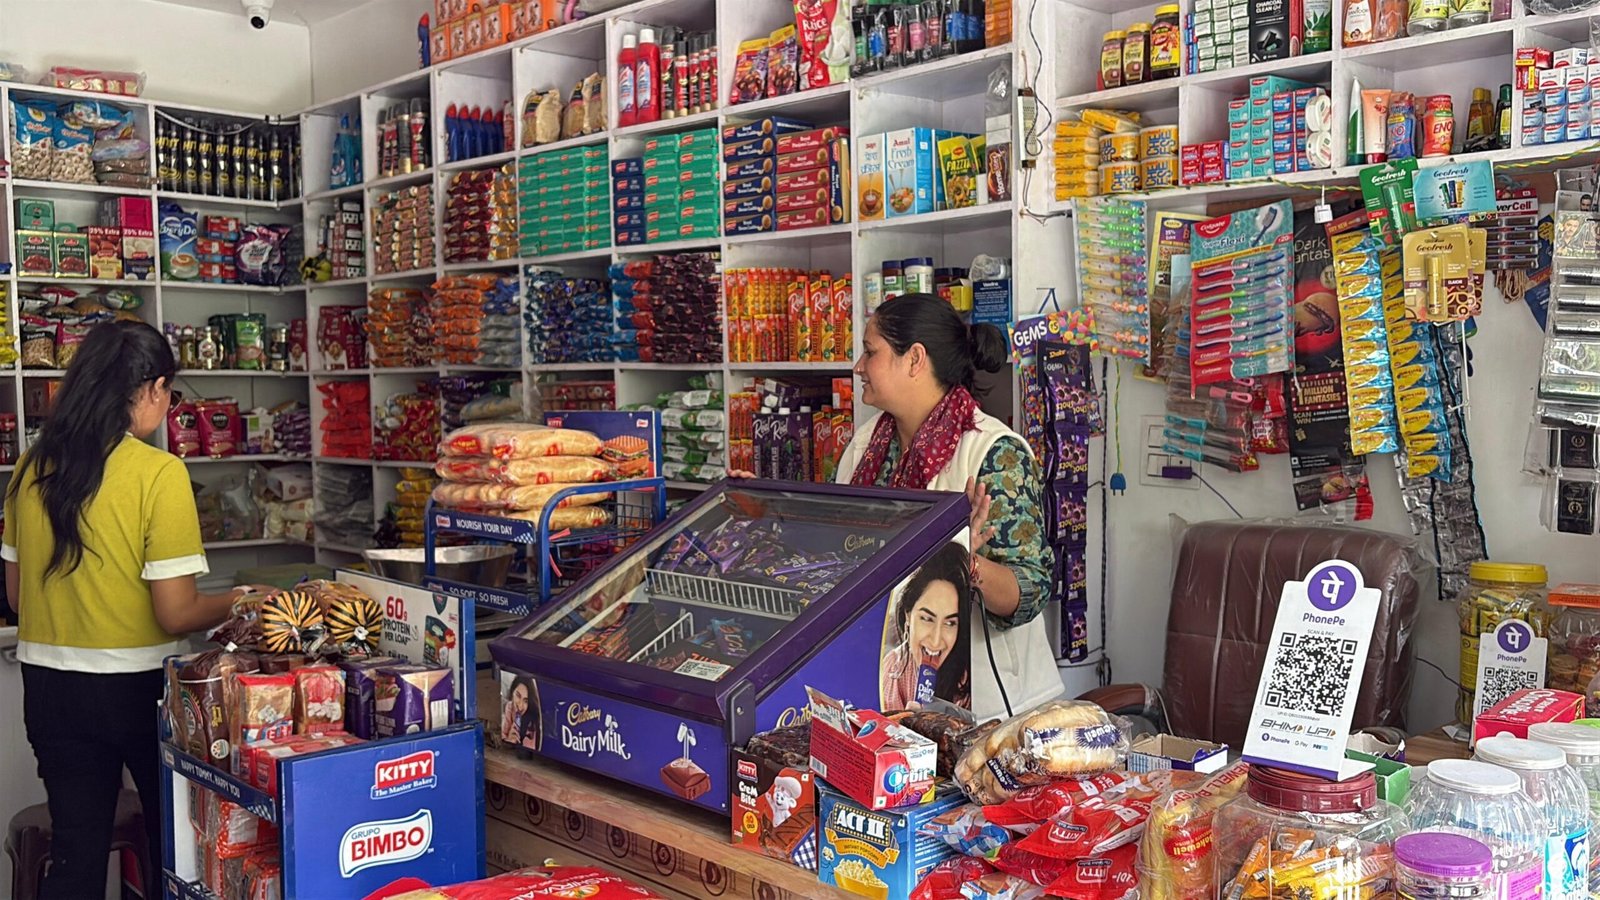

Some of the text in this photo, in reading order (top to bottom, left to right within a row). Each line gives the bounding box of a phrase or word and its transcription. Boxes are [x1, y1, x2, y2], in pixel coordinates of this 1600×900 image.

[1256, 6, 1272, 14] CLEAN
[1434, 122, 1452, 134] ENO
[893, 138, 910, 146] Amul
[891, 147, 911, 159] Fresh
[888, 158, 914, 169] Cream
[1200, 220, 1225, 231] Colgate
[1416, 243, 1453, 252] Geofresh
[1014, 321, 1047, 346] GEMS
[1304, 385, 1334, 397] MILLION
[1304, 393, 1340, 404] FANTASIES
[456, 519, 482, 530] NOURISH
[482, 522, 500, 533] YOUR
[500, 526, 512, 535] DAY
[479, 592, 489, 601] SO
[490, 594, 508, 606] FRESH
[1302, 612, 1345, 626] PhonePe
[383, 618, 410, 635] PROTEIN
[385, 632, 394, 641] PER
[1497, 654, 1527, 663] PhonePe
[918, 684, 935, 697] Dairy
[567, 702, 601, 726] Cadbury
[1261, 719, 1332, 736] BHIM UPI
[561, 725, 632, 760] Dairy Milk
[1270, 737, 1290, 745] PhonePe
[379, 755, 431, 782] KITTY
[181, 759, 240, 798] HAPPY TUMMY, HAPPY YOU
[375, 777, 433, 797] The Master Baker
[741, 792, 756, 807] Bite
[836, 809, 885, 839] ACT II
[351, 827, 381, 839] GRUPO
[1052, 829, 1082, 842] KITTY
[351, 827, 424, 861] BIMBO
